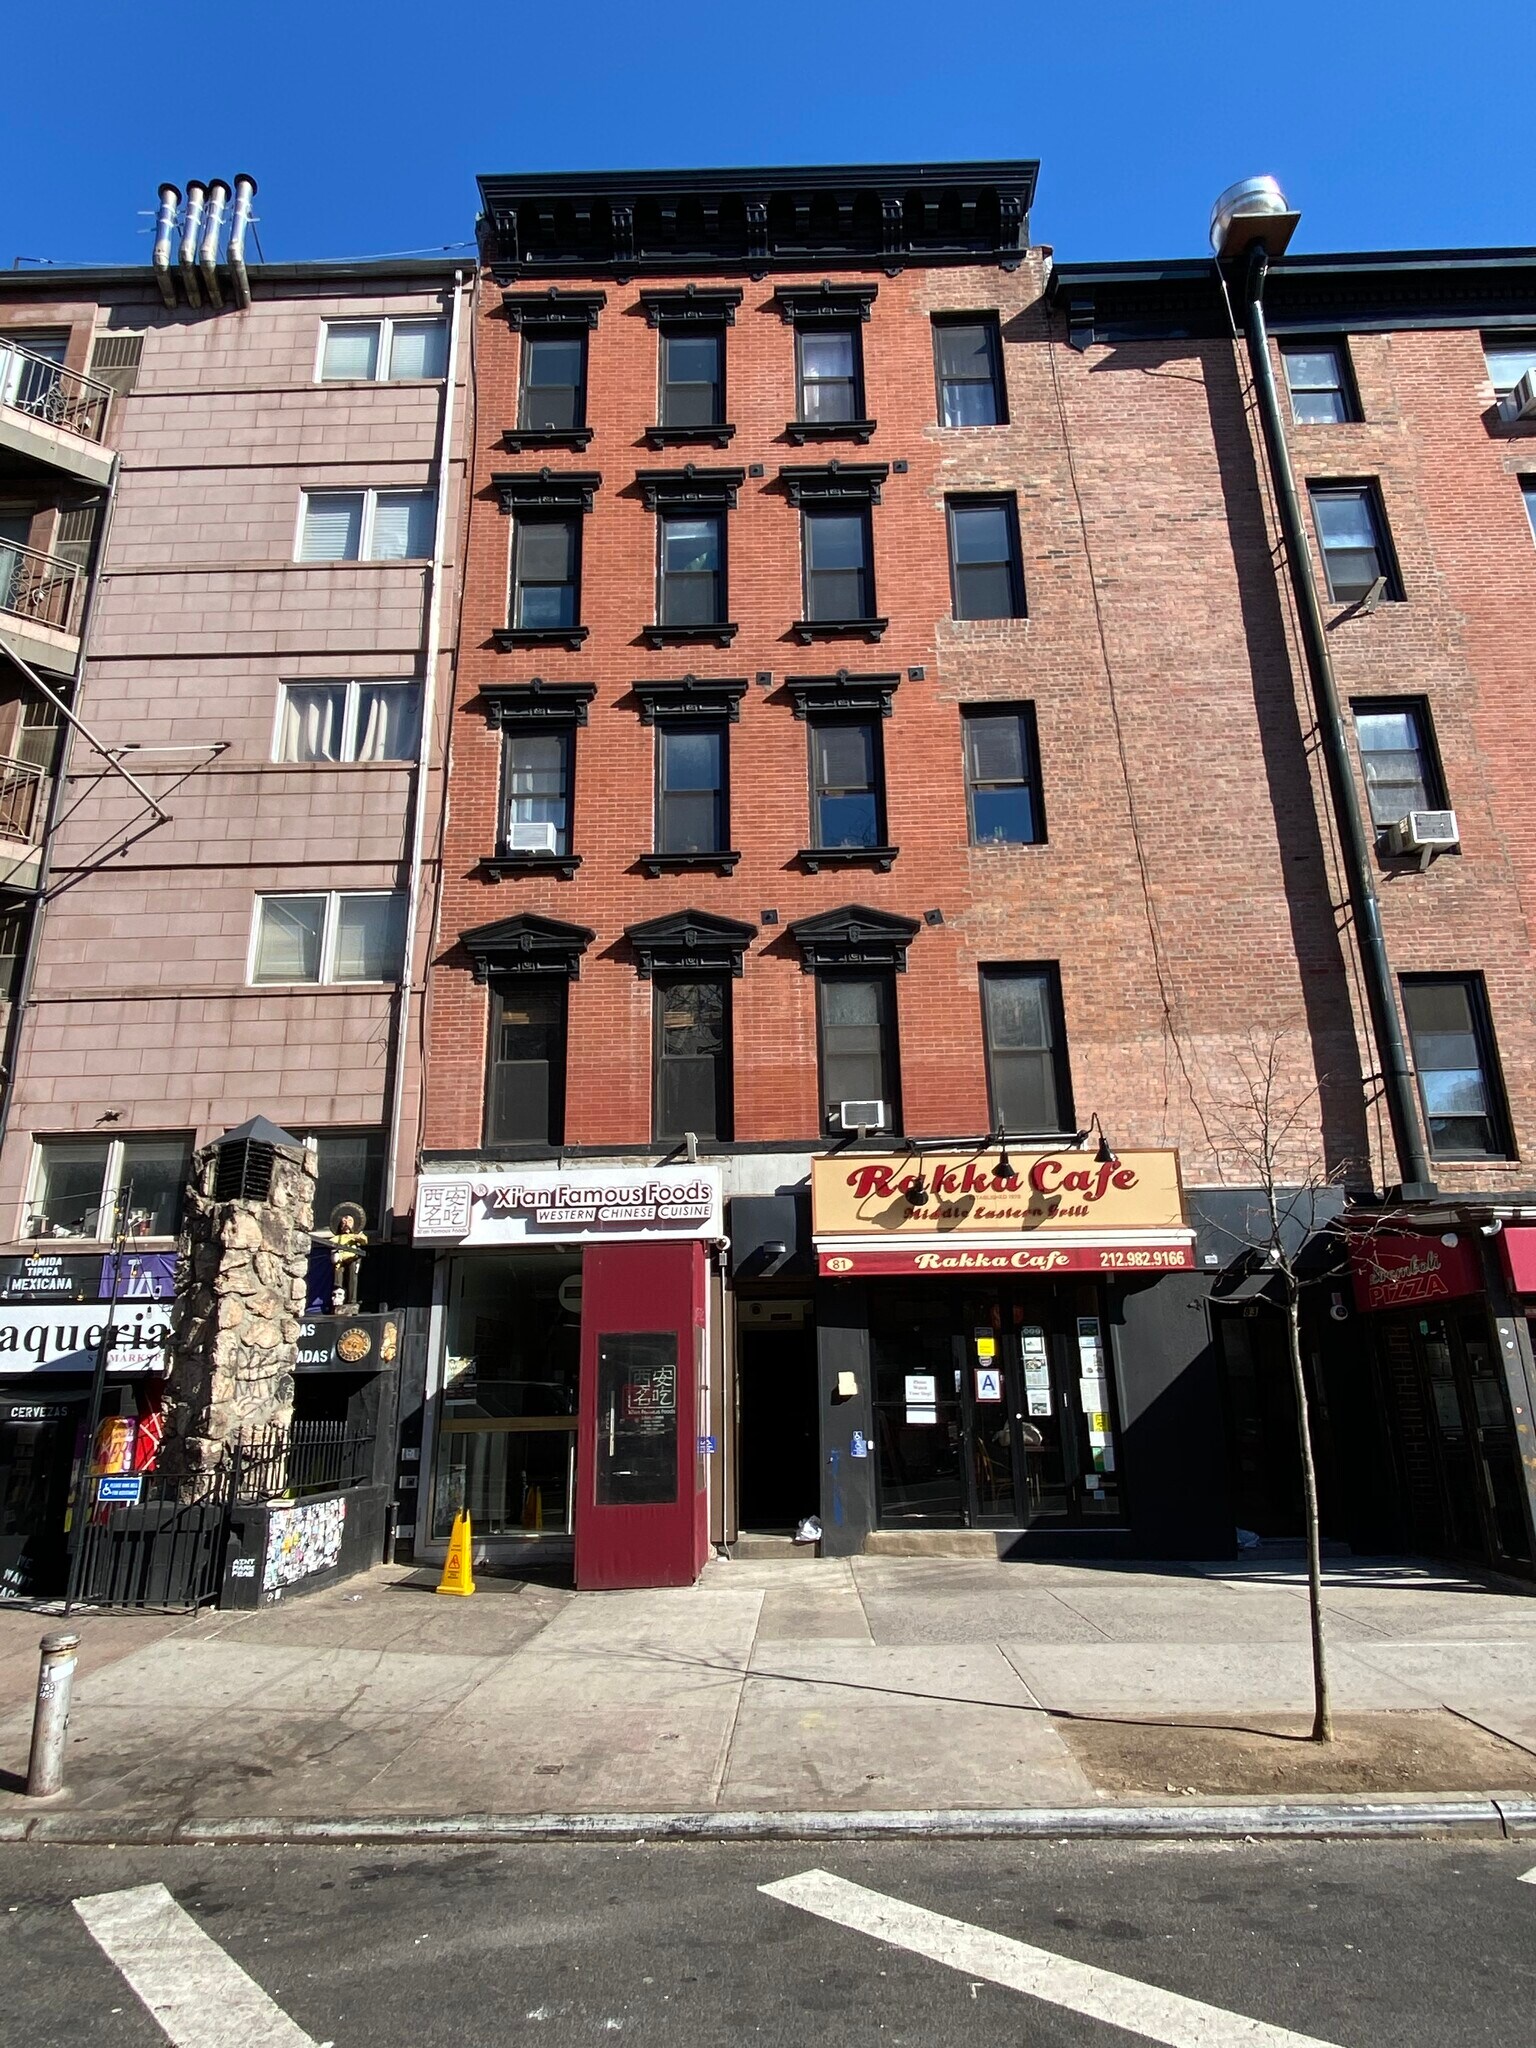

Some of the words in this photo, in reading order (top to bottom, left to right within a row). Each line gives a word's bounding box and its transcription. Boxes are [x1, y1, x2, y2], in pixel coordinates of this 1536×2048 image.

[847, 1163, 1024, 1198] Rakka
[1031, 1159, 1139, 1201] Cafe
[497, 1186, 549, 1206] Xi'an
[559, 1185, 641, 1205] Famous
[649, 1182, 710, 1202] Foods
[539, 1210, 594, 1221] WESTERN
[601, 1207, 654, 1219] CHINESE
[660, 1205, 711, 1217] CUISINE
[904, 1207, 969, 1220] Middle
[974, 1206, 1042, 1219] Eastern
[1048, 1205, 1089, 1219] Grill
[24, 1257, 62, 1266] COMIDA
[832, 1260, 847, 1270] 81
[914, 1252, 1009, 1269] Rakka
[1011, 1251, 1070, 1270] Cafe
[1100, 1251, 1185, 1267] 212.982.9166
[27, 1267, 59, 1276] TIPICA
[11, 1278, 73, 1291] MEXICANA
[1369, 1273, 1448, 1306] PIZZA
[982, 1375, 995, 1391] A
[11, 1406, 68, 1418] CERVEZAS
